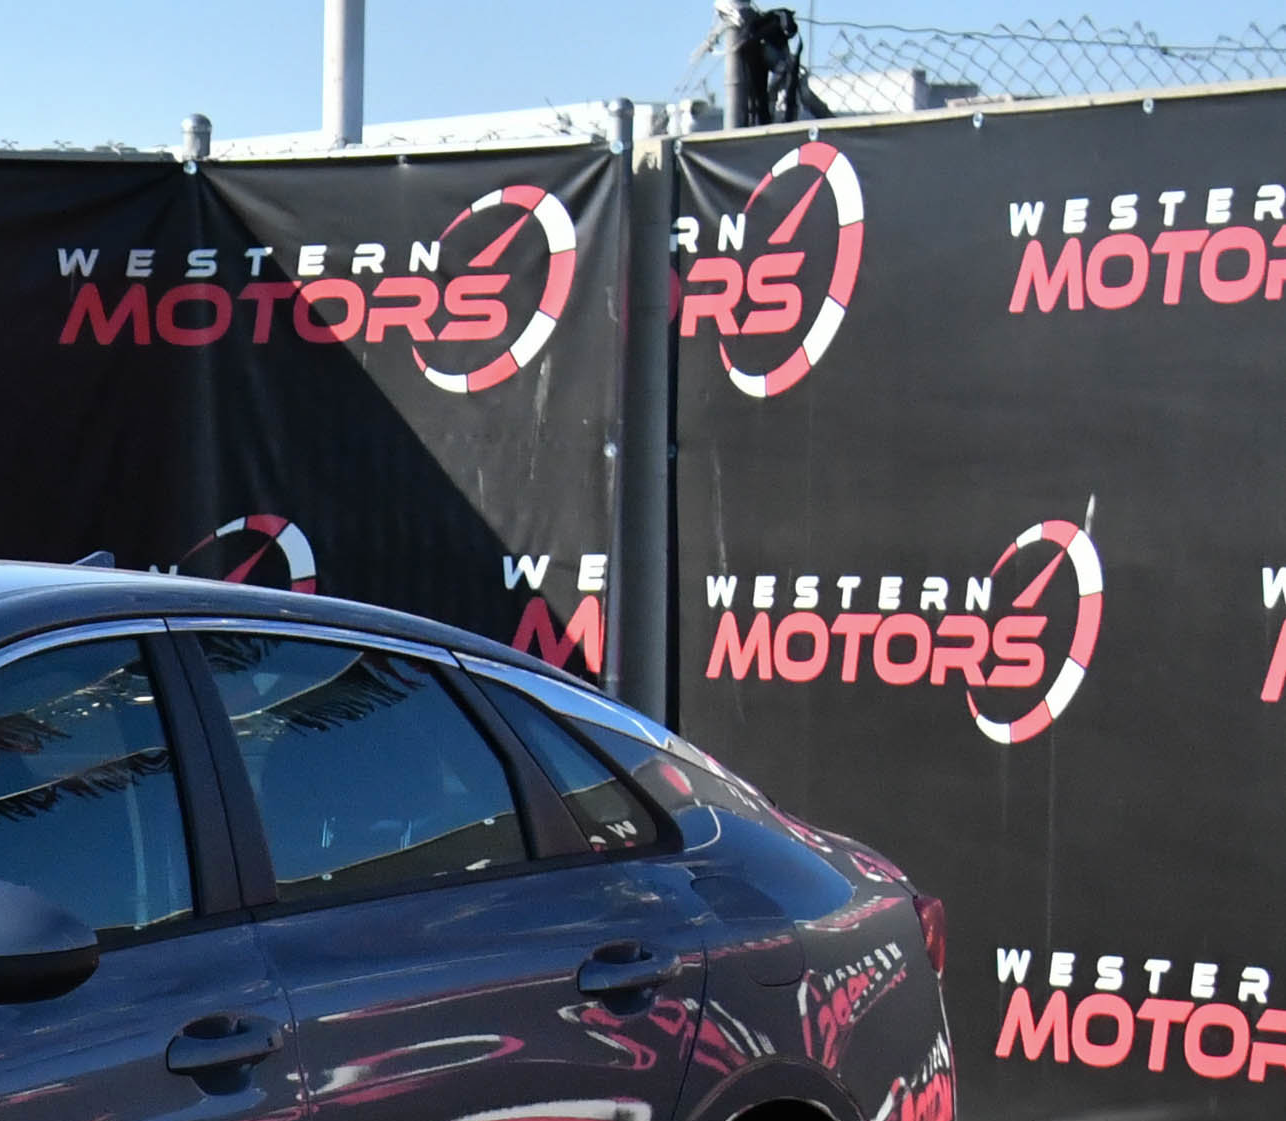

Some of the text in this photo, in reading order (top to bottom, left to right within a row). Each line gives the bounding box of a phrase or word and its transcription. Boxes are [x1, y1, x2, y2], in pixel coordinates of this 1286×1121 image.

[58, 240, 441, 277] WESTERN
[670, 250, 805, 337] RS
[60, 273, 512, 346] MOTORS
[705, 574, 993, 612] WESTERN
[704, 610, 1049, 689] MOTORS
